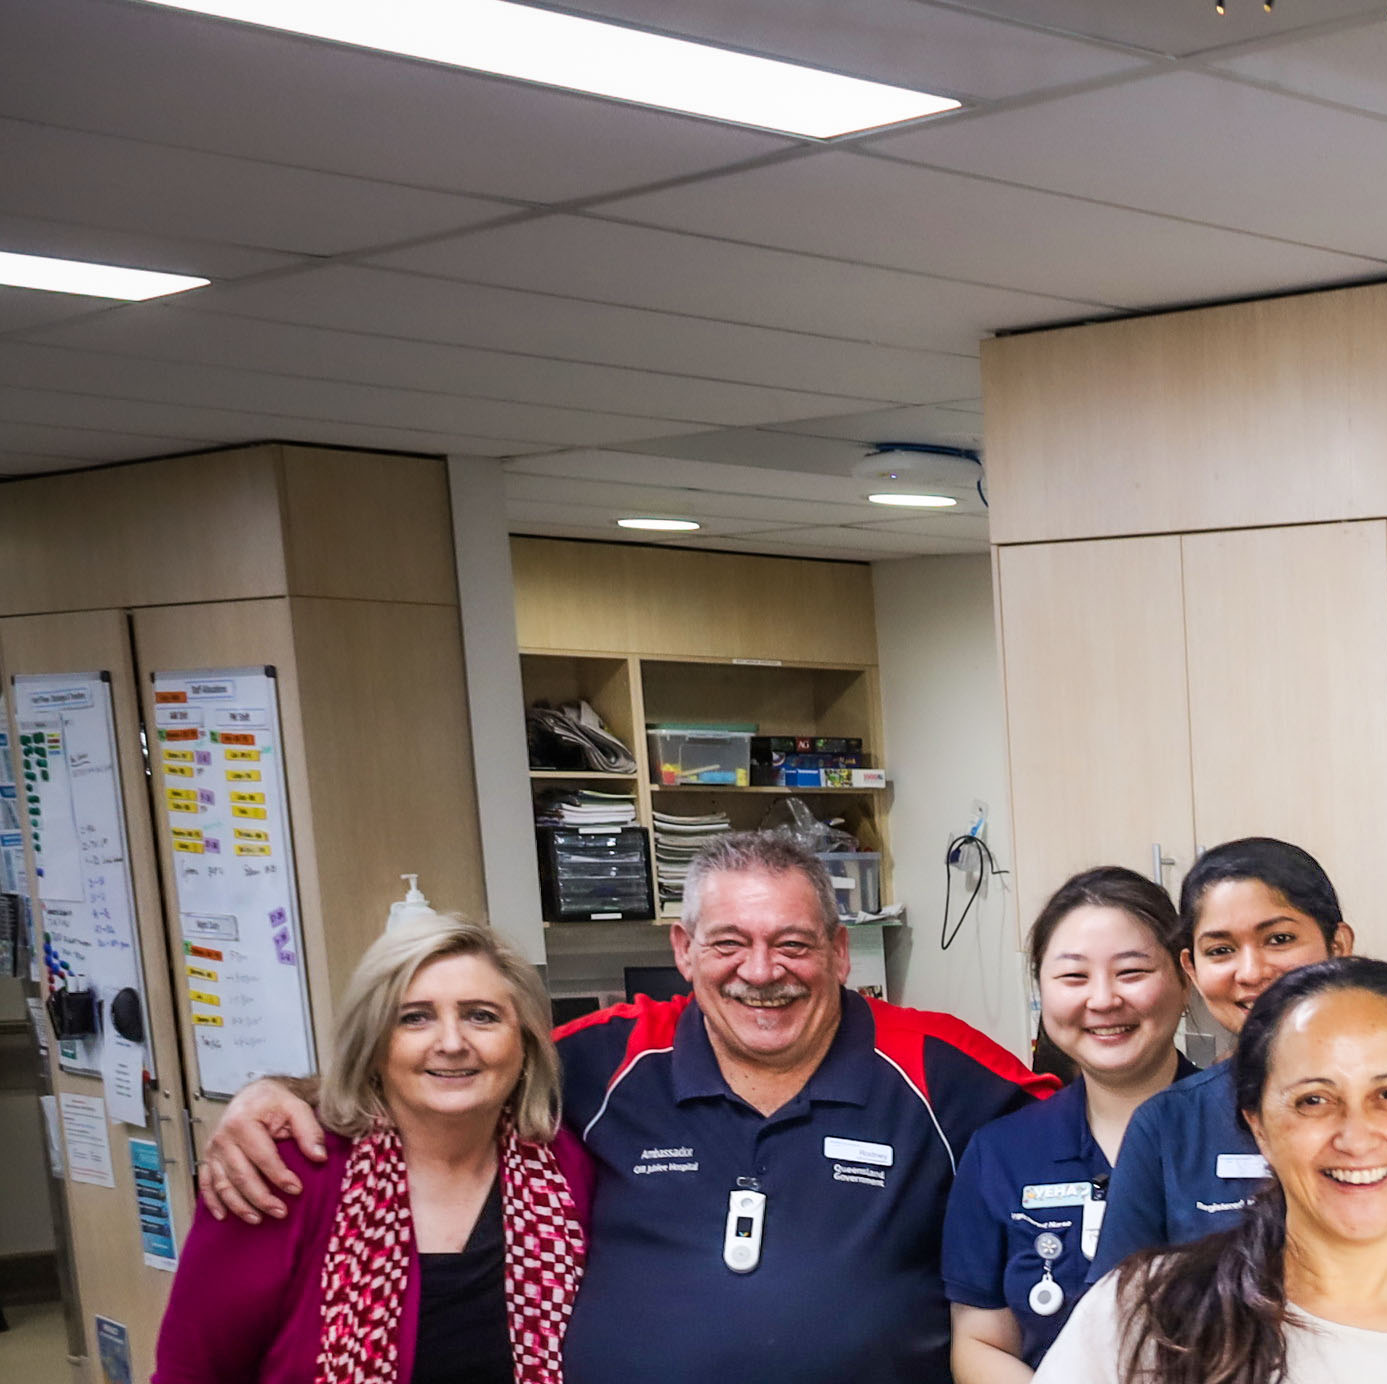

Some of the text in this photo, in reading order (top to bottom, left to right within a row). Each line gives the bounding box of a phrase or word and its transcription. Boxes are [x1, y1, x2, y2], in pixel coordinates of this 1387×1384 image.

[640, 1146, 694, 1160] Ambassador
[669, 1161, 699, 1173] Hospital
[833, 1163, 885, 1180] Queensland
[833, 1172, 885, 1188] Government
